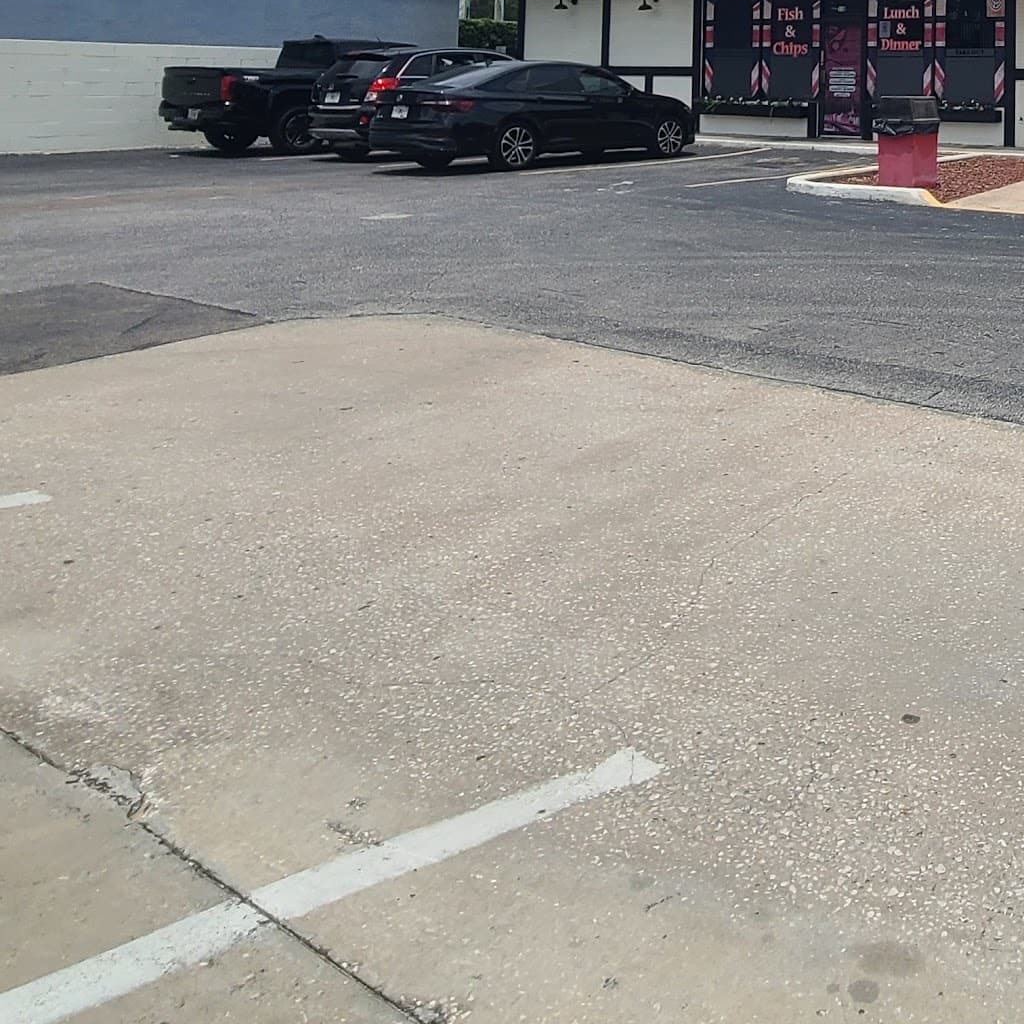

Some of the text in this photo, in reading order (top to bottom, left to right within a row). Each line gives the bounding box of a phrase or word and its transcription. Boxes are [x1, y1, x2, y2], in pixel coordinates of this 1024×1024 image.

[777, 6, 804, 21] Fish
[883, 5, 920, 20] Lunch
[784, 24, 796, 38] &
[895, 22, 907, 35] &
[772, 41, 808, 58] Chips
[880, 38, 922, 51] Dinner
